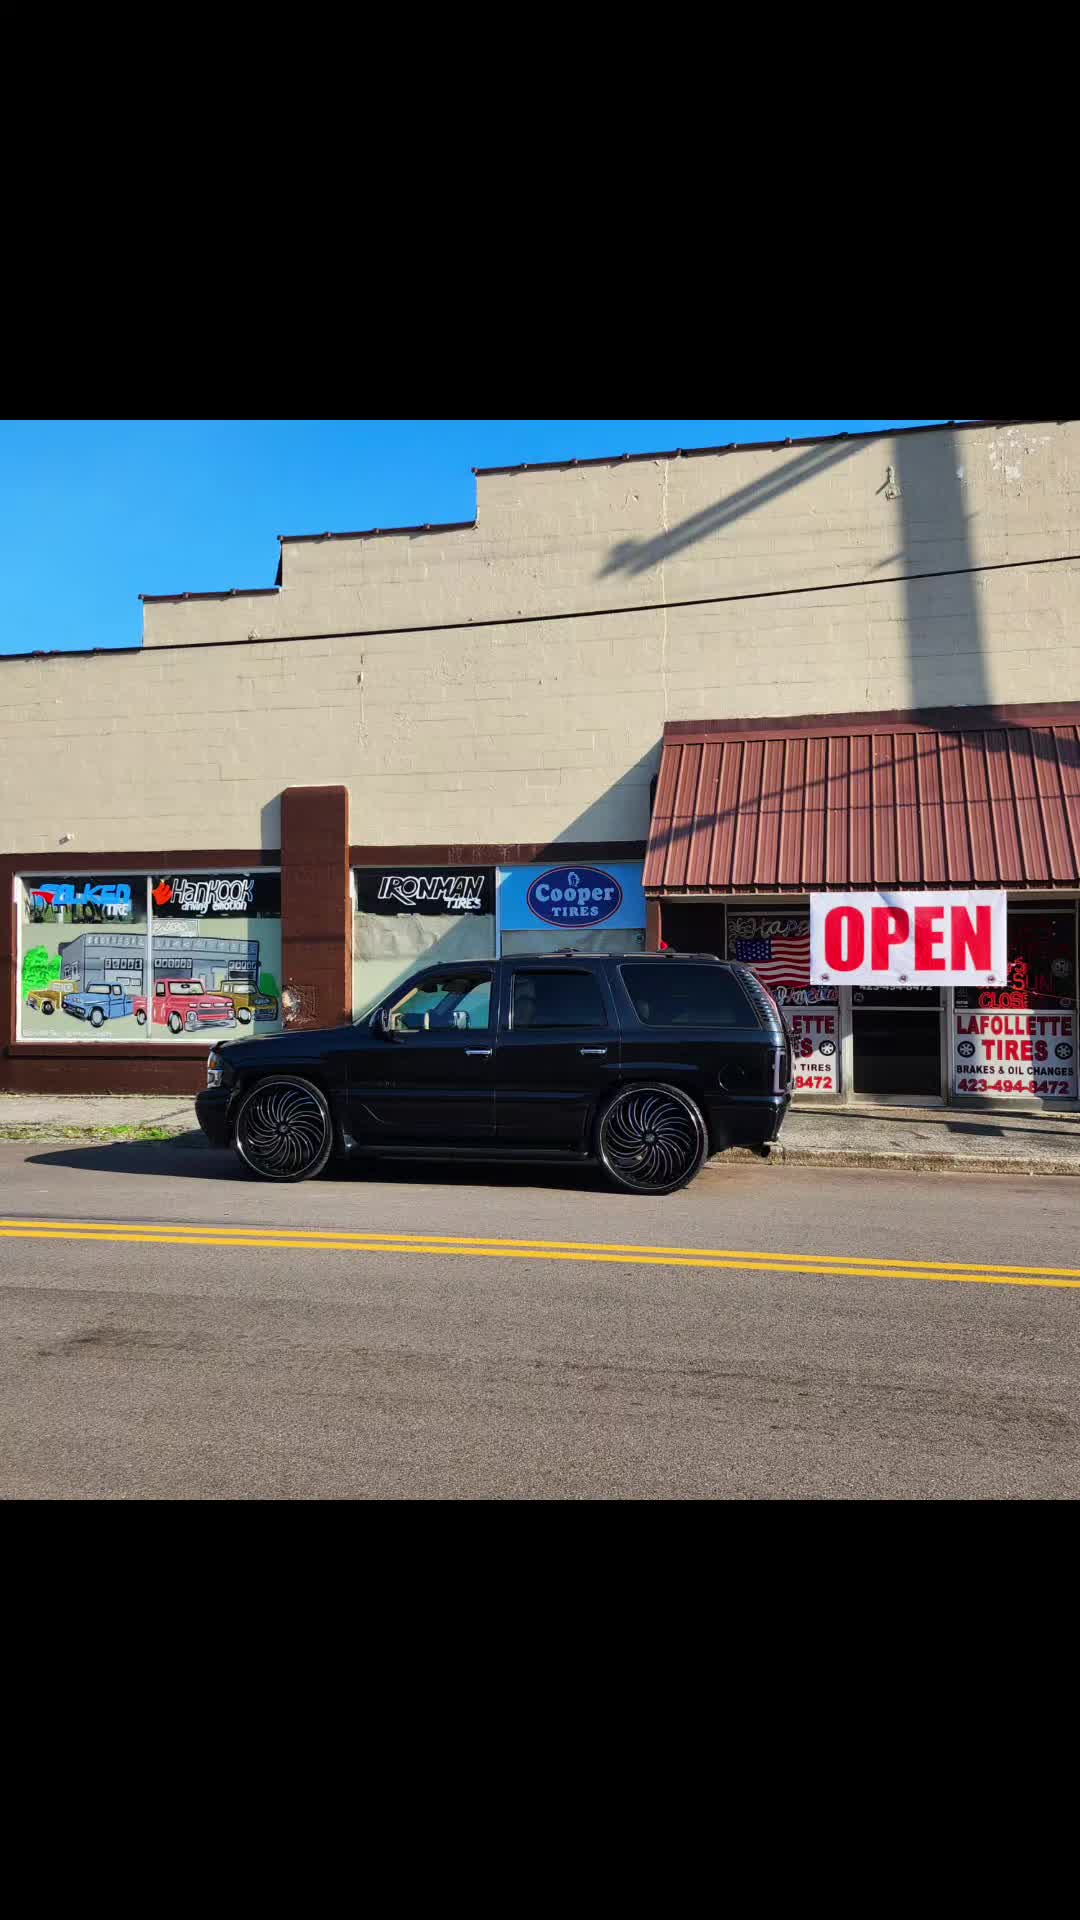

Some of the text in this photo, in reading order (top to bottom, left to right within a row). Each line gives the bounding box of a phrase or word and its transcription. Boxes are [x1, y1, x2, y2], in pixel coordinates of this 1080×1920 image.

[377, 876, 485, 905] IRONMAN
[535, 883, 615, 905] Cooper
[105, 903, 128, 915] TIRE
[444, 898, 481, 909] TIRES
[551, 906, 599, 917] TIRES
[824, 905, 992, 972] OPEN
[956, 1015, 1073, 1036] LAFOLLETTE
[981, 1039, 1049, 1061] TIRES
[800, 1063, 832, 1072] TIRES
[956, 1065, 1074, 1077] BRAKES & OIL CHANGES
[957, 1078, 1071, 1094] 423-494-8472
